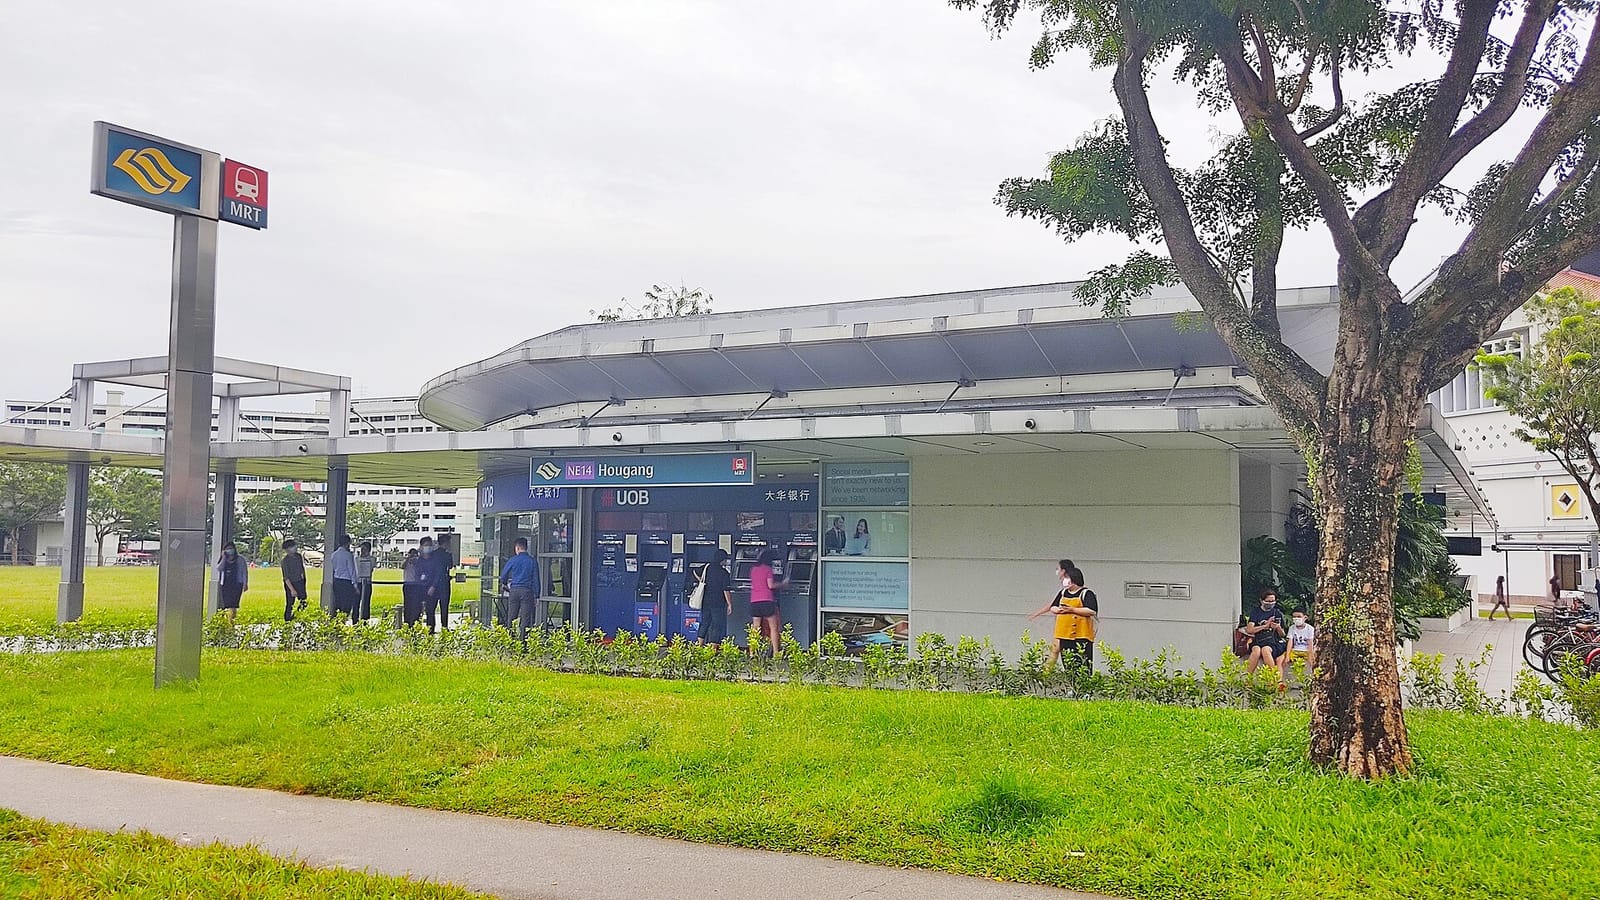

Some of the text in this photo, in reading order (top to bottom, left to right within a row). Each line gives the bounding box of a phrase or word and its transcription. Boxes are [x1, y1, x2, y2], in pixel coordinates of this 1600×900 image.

[230, 201, 261, 222] MRT
[567, 463, 654, 479] NE14 Hougang
[482, 486, 494, 508] UOB
[617, 489, 650, 505] UOB
[765, 489, 810, 502] 大华银行
[852, 486, 868, 494] been
[869, 486, 906, 494] networking
